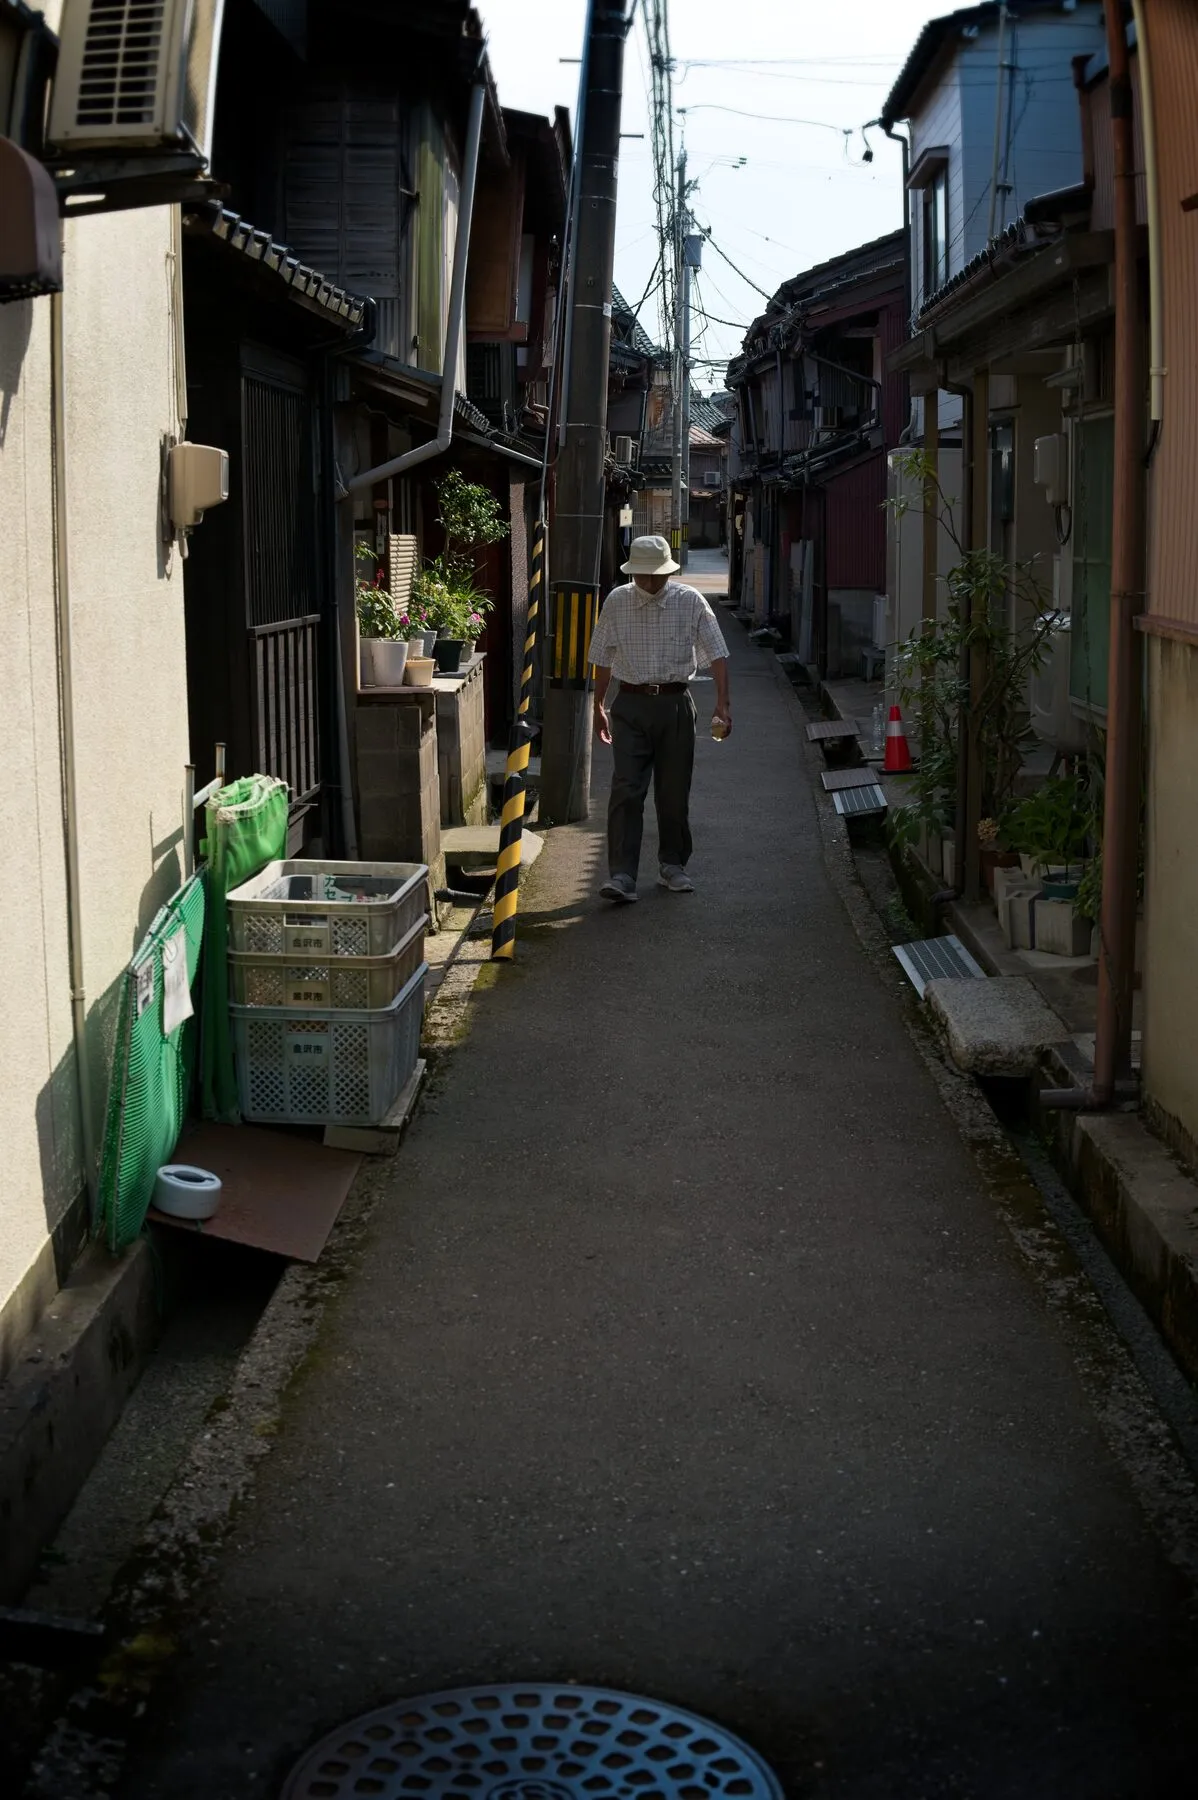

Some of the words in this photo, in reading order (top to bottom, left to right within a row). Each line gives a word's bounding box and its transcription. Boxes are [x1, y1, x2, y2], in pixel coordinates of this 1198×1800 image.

[293, 938, 323, 948] 金沢市
[293, 991, 323, 1002] 金沢市
[293, 1043, 323, 1055] 金沢市
